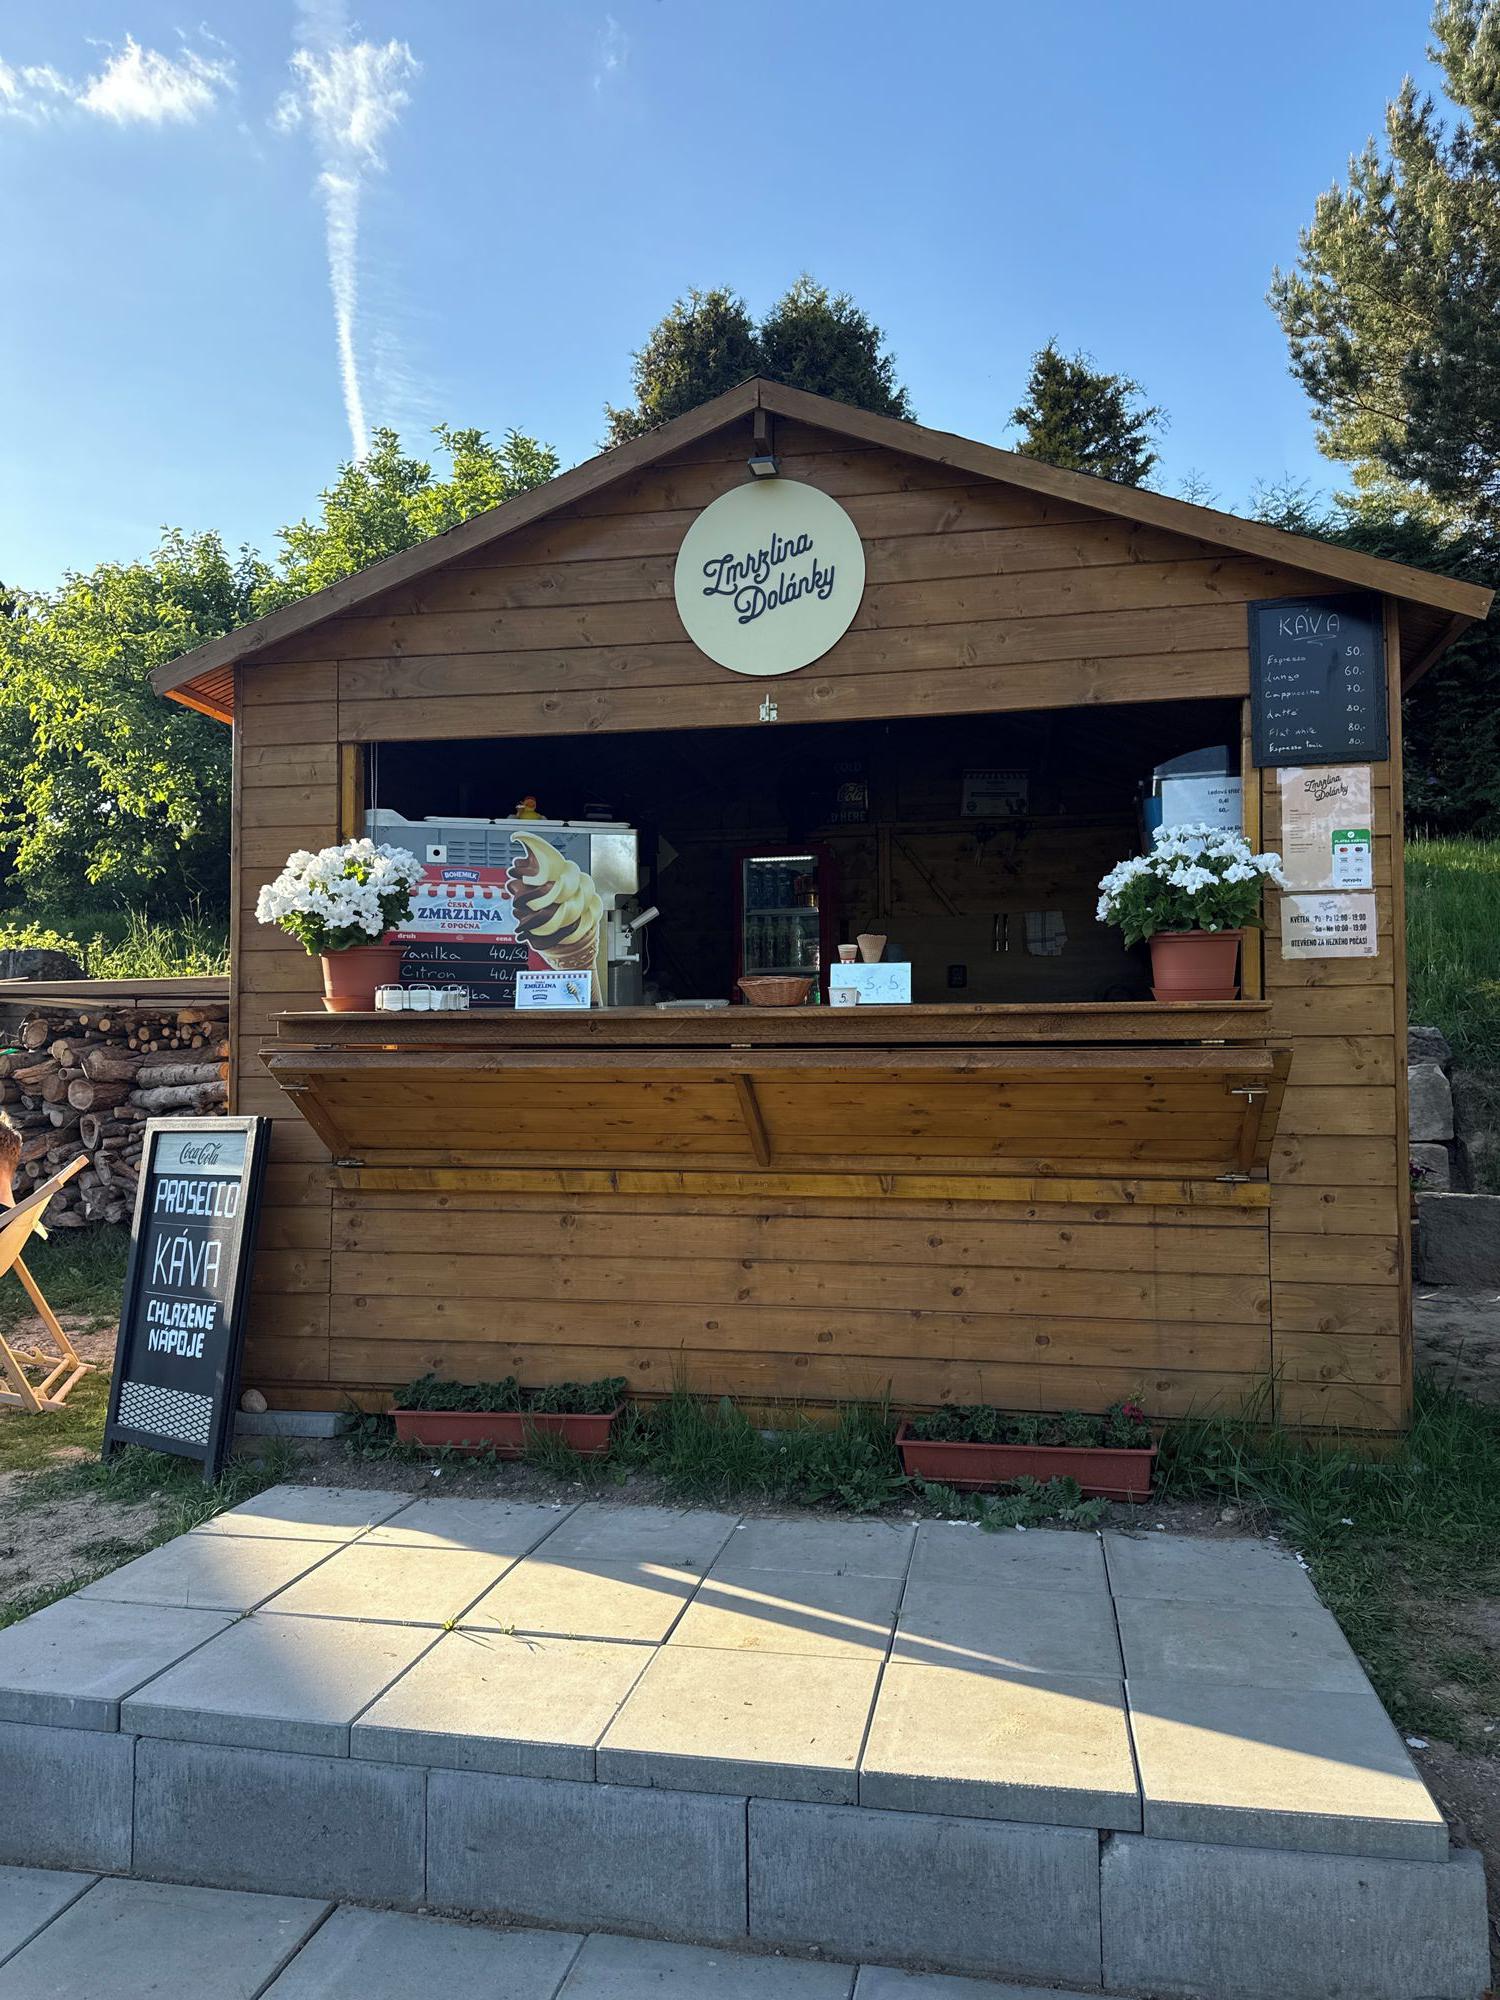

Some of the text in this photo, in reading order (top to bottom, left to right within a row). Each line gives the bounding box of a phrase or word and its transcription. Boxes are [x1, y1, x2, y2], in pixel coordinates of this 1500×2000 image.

[703, 533, 813, 596] Zmrzlina
[734, 558, 835, 624] Dolánky
[1279, 608, 1340, 636] KÁVA
[1267, 654, 1306, 666] Espresso
[1304, 774, 1341, 792] Zmrzlina
[1314, 783, 1348, 801] Dolánky
[444, 871, 478, 880] BOHEMILK
[447, 899, 474, 909] ČESKÁ
[417, 907, 503, 921] ZMRZLINA
[1290, 913, 1310, 923] KVĚTEN
[447, 921, 481, 929] OPOČNA
[401, 964, 456, 979] Citron
[154, 1178, 241, 1218] PROSECCO
[152, 1228, 222, 1288] KÁVA
[146, 1299, 217, 1331] CHLAZENÉ
[148, 1327, 205, 1359] NÁPOJE
